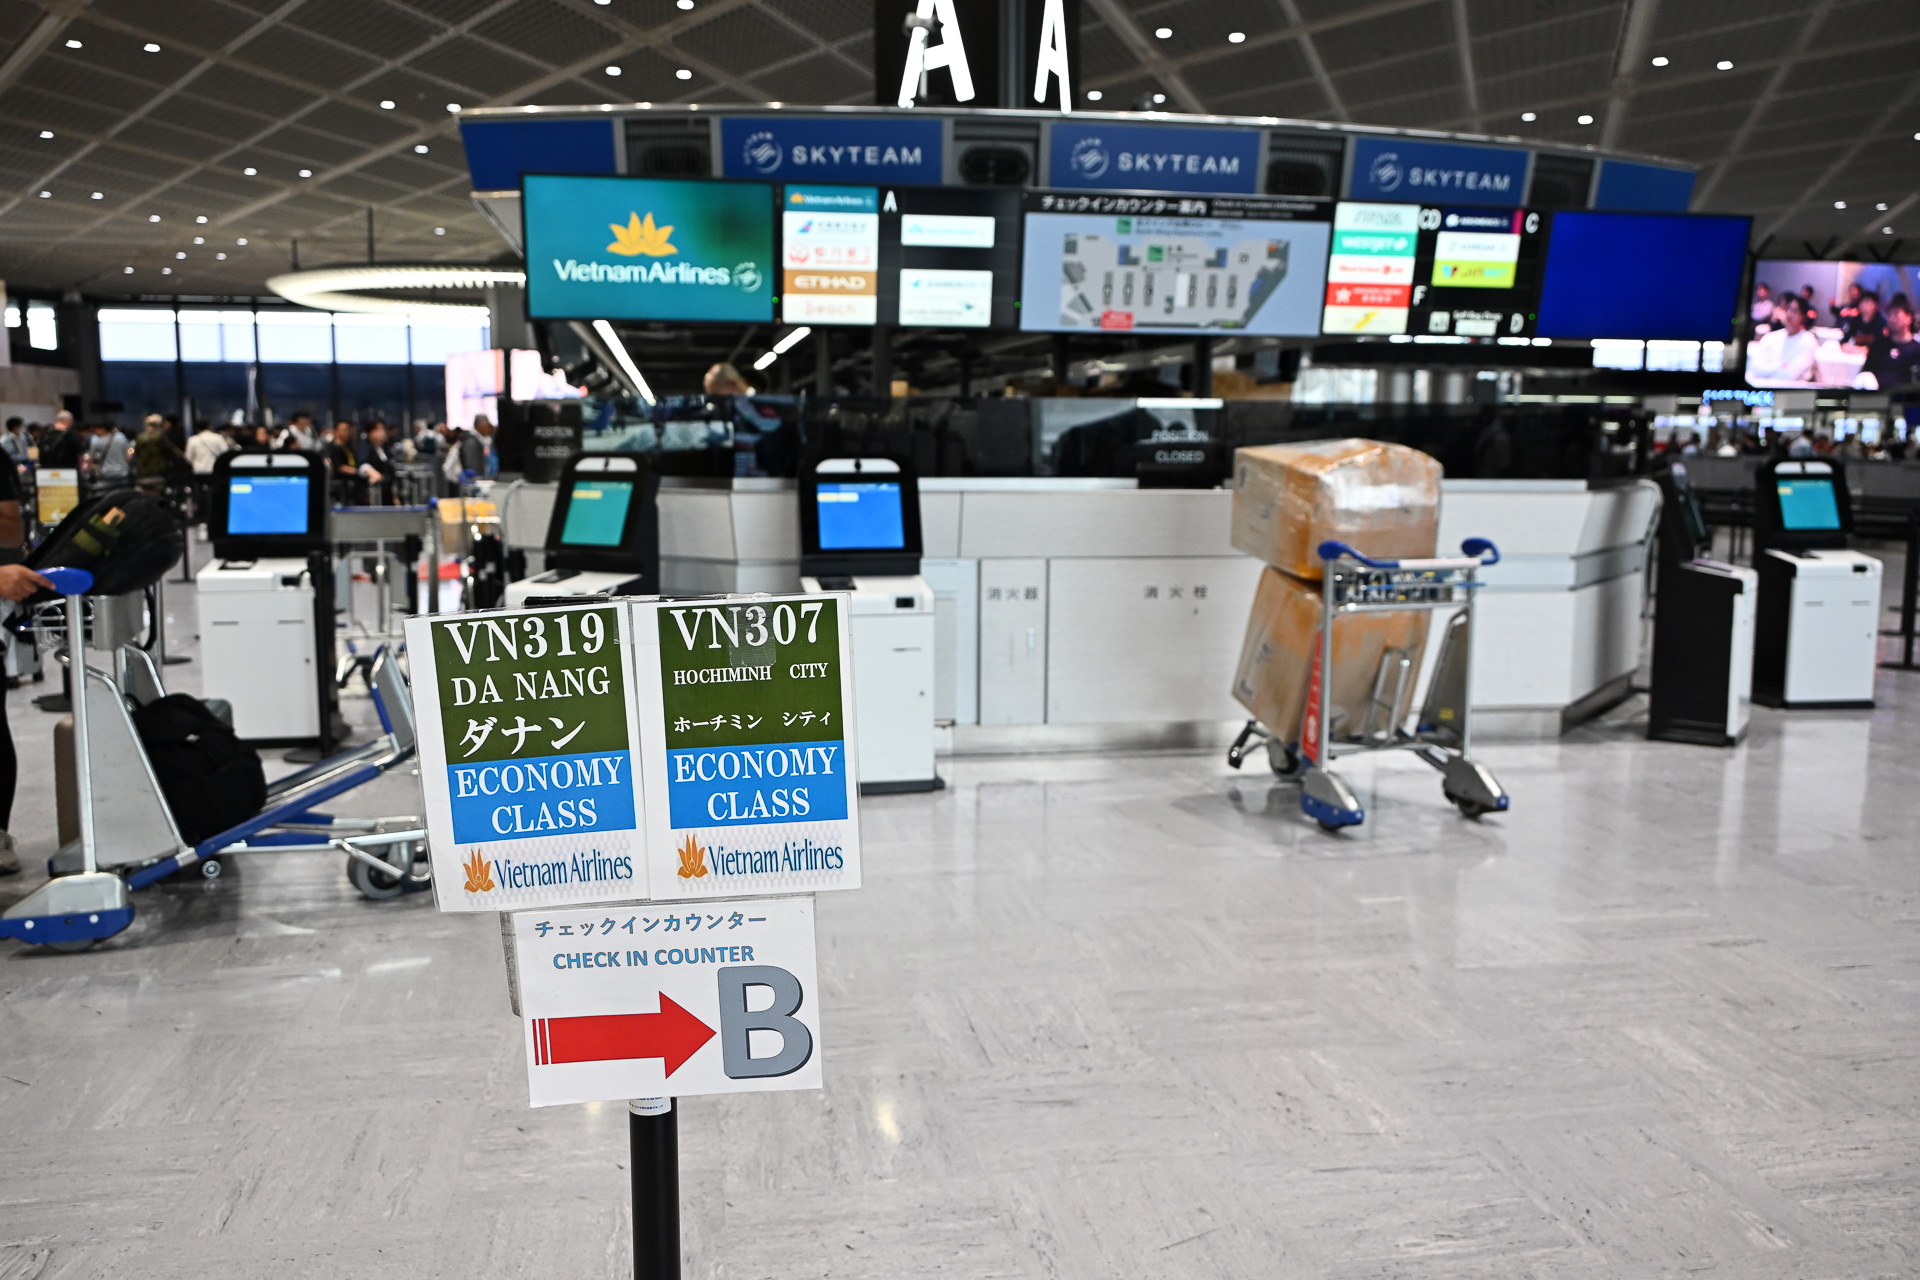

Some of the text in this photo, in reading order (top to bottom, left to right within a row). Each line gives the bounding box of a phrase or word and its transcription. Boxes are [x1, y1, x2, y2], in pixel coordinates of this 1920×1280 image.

[791, 144, 923, 166] SKYTEAM
[1116, 151, 1241, 176] SKYTEAM
[1408, 165, 1513, 192] SKYTEAM
[882, 189, 898, 213] A
[1525, 212, 1540, 234] C
[552, 258, 649, 284] Vietnam
[649, 261, 731, 286] Airlines
[793, 274, 867, 290] ETIHAD
[1412, 284, 1428, 307] F
[1154, 449, 1206, 464] CLOSED
[986, 586, 1039, 601] 消火器
[443, 611, 605, 666] VN319
[669, 601, 824, 652] VN307
[450, 666, 611, 707] DA NANG
[673, 662, 829, 686] HOCHIMINH CITY
[673, 708, 832, 734] ホーチミン シティ
[458, 714, 586, 758] ダナン
[455, 755, 624, 799] ECONOMY
[673, 745, 838, 783] ECONOMY
[490, 797, 598, 835] CLASS
[706, 786, 811, 822] CLASS
[494, 849, 633, 891] Vietnam Airlines
[708, 838, 844, 876] Vietnam Airlines
[533, 911, 767, 939] チェックインカウンター
[552, 944, 755, 970] CHECK IN COUNTER
[716, 964, 814, 1081] B
